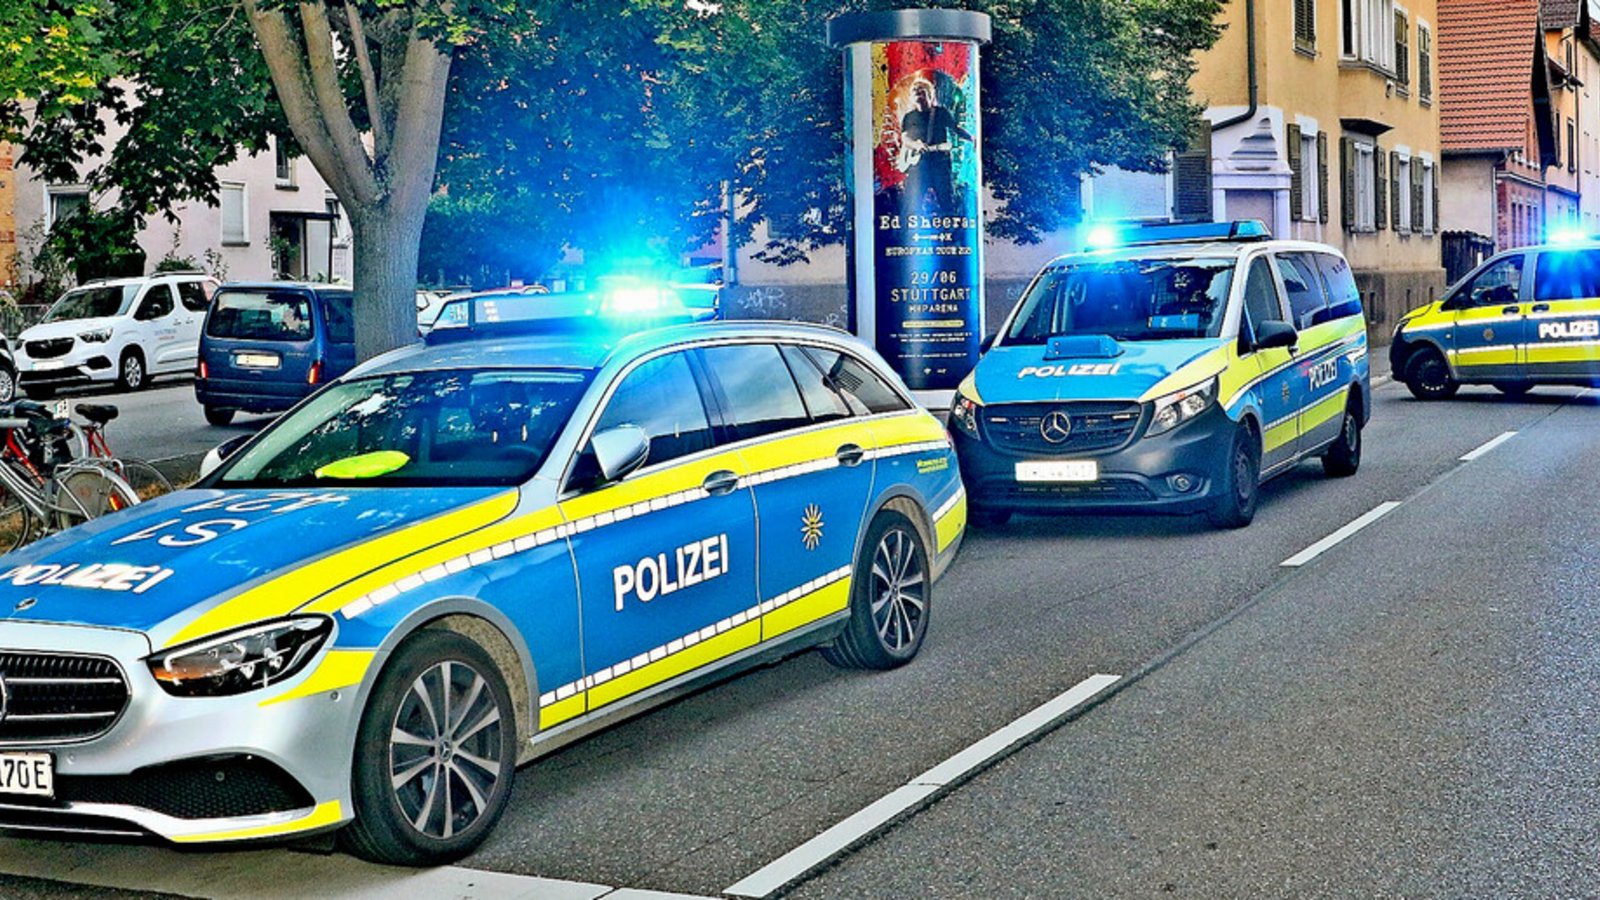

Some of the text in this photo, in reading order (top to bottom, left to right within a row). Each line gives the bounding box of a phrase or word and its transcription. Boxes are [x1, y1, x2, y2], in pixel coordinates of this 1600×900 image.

[880, 215, 900, 229] Ed
[911, 271, 956, 285] 29/06
[891, 288, 971, 302] STUTTGART
[1539, 320, 1598, 338] POLIZEI
[1018, 362, 1120, 378] POLIZEI
[0, 563, 174, 593] POLIZEI
[614, 533, 728, 611] POLIZEI
[0, 759, 48, 789] 70E
